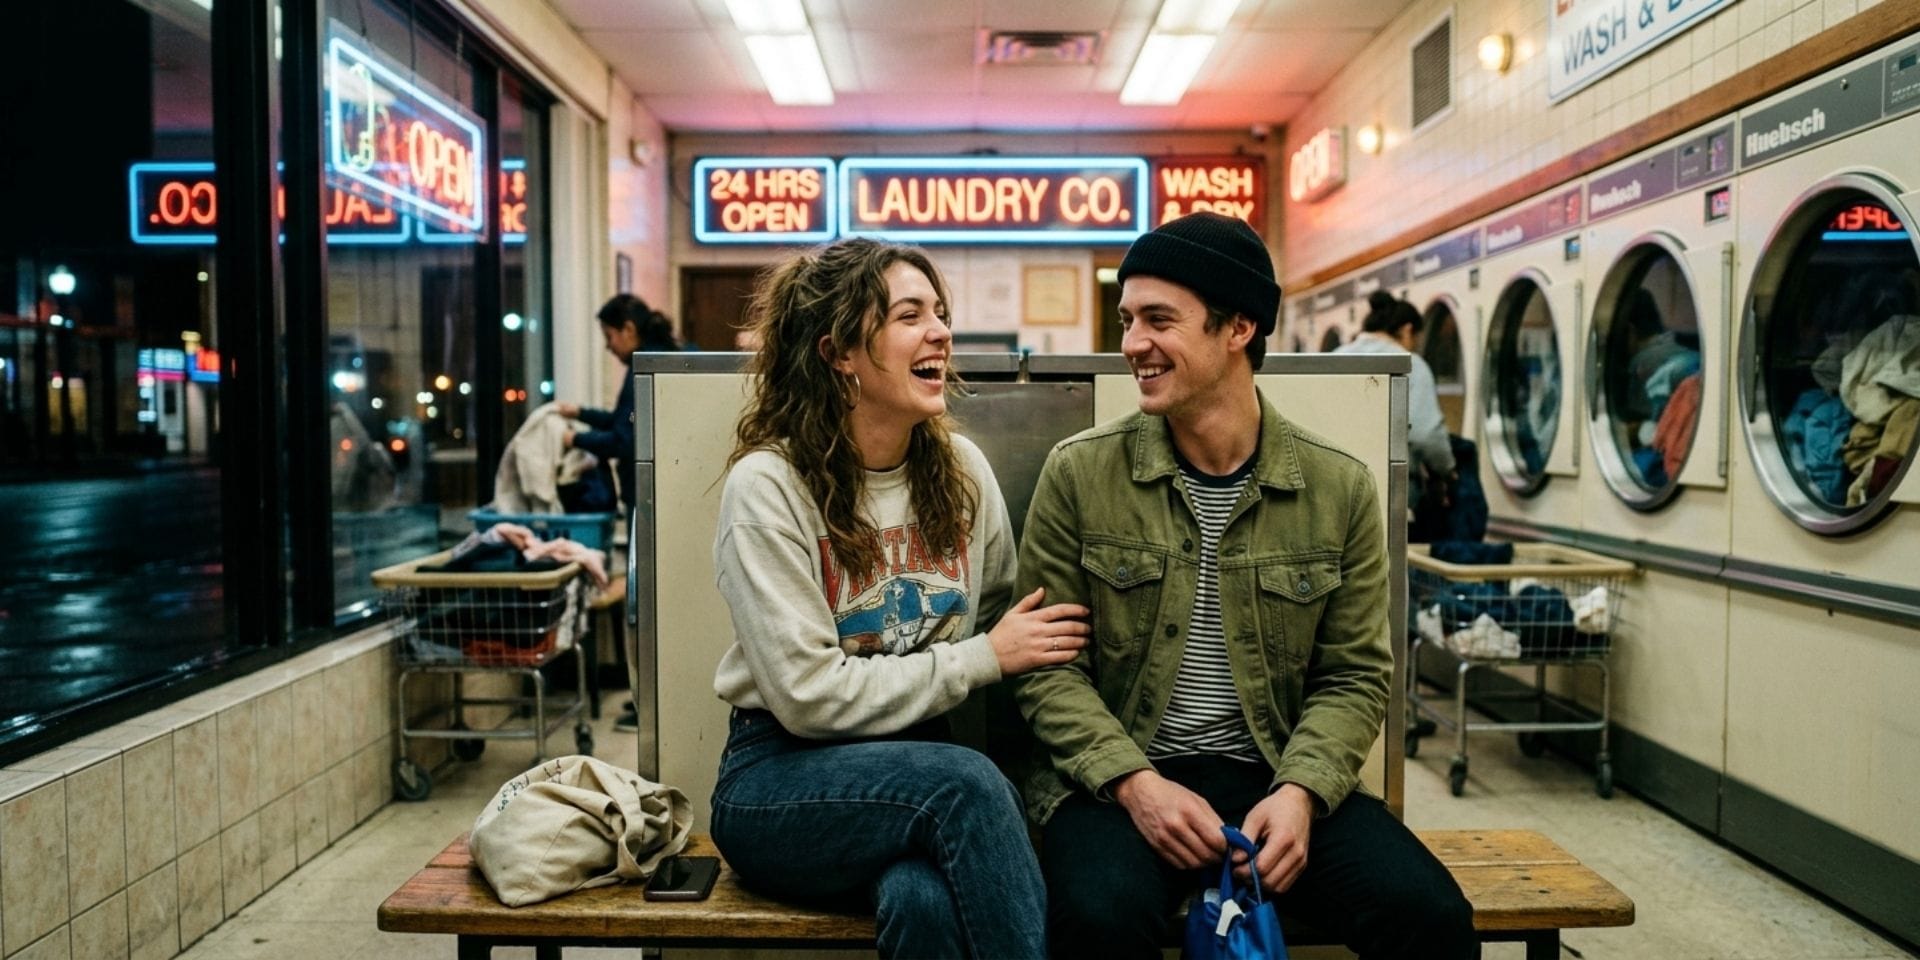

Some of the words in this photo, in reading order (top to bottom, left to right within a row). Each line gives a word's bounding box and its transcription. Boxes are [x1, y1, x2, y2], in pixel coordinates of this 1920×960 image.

[1562, 2, 1627, 75] WASH
[1745, 107, 1826, 158] Huebsch
[408, 120, 474, 207] OPEN
[710, 168, 750, 200] 24
[754, 168, 820, 199] HRS
[1160, 167, 1254, 198] WASH
[721, 201, 809, 232] OPEN
[857, 176, 1050, 223] LAUNDRY
[1058, 176, 1131, 223] CO.
